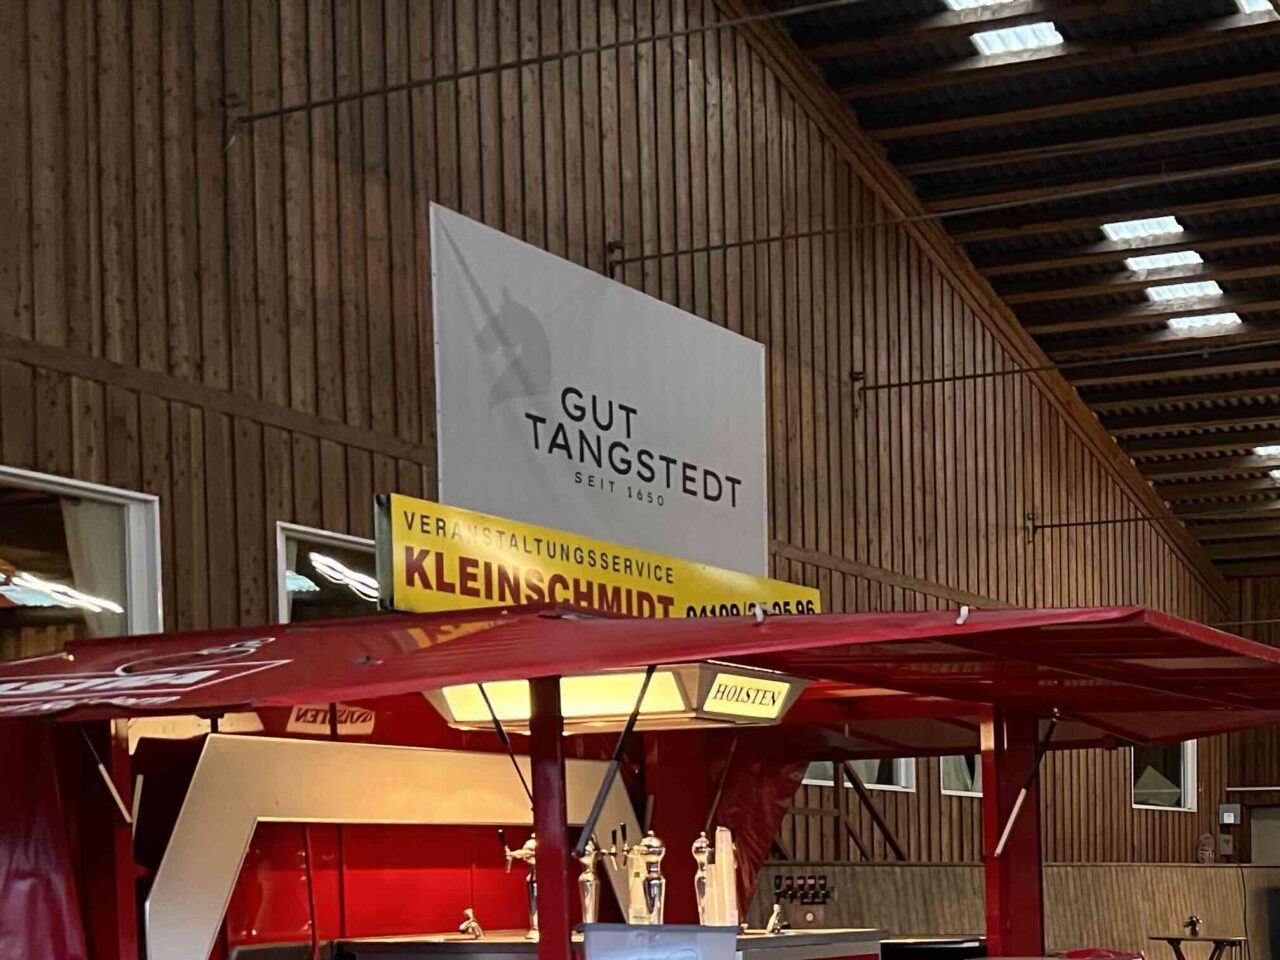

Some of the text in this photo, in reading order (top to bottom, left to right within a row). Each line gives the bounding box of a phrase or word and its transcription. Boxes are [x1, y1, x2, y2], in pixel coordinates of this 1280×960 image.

[561, 387, 637, 439] GUT
[525, 412, 742, 507] TANGSTEDT
[574, 471, 664, 506] SEIT 1650
[403, 510, 675, 584] VERANSTALTUNGSSERVICE
[404, 545, 675, 618] KLEINSCHMIDT
[712, 683, 781, 707] HOLSTEN
